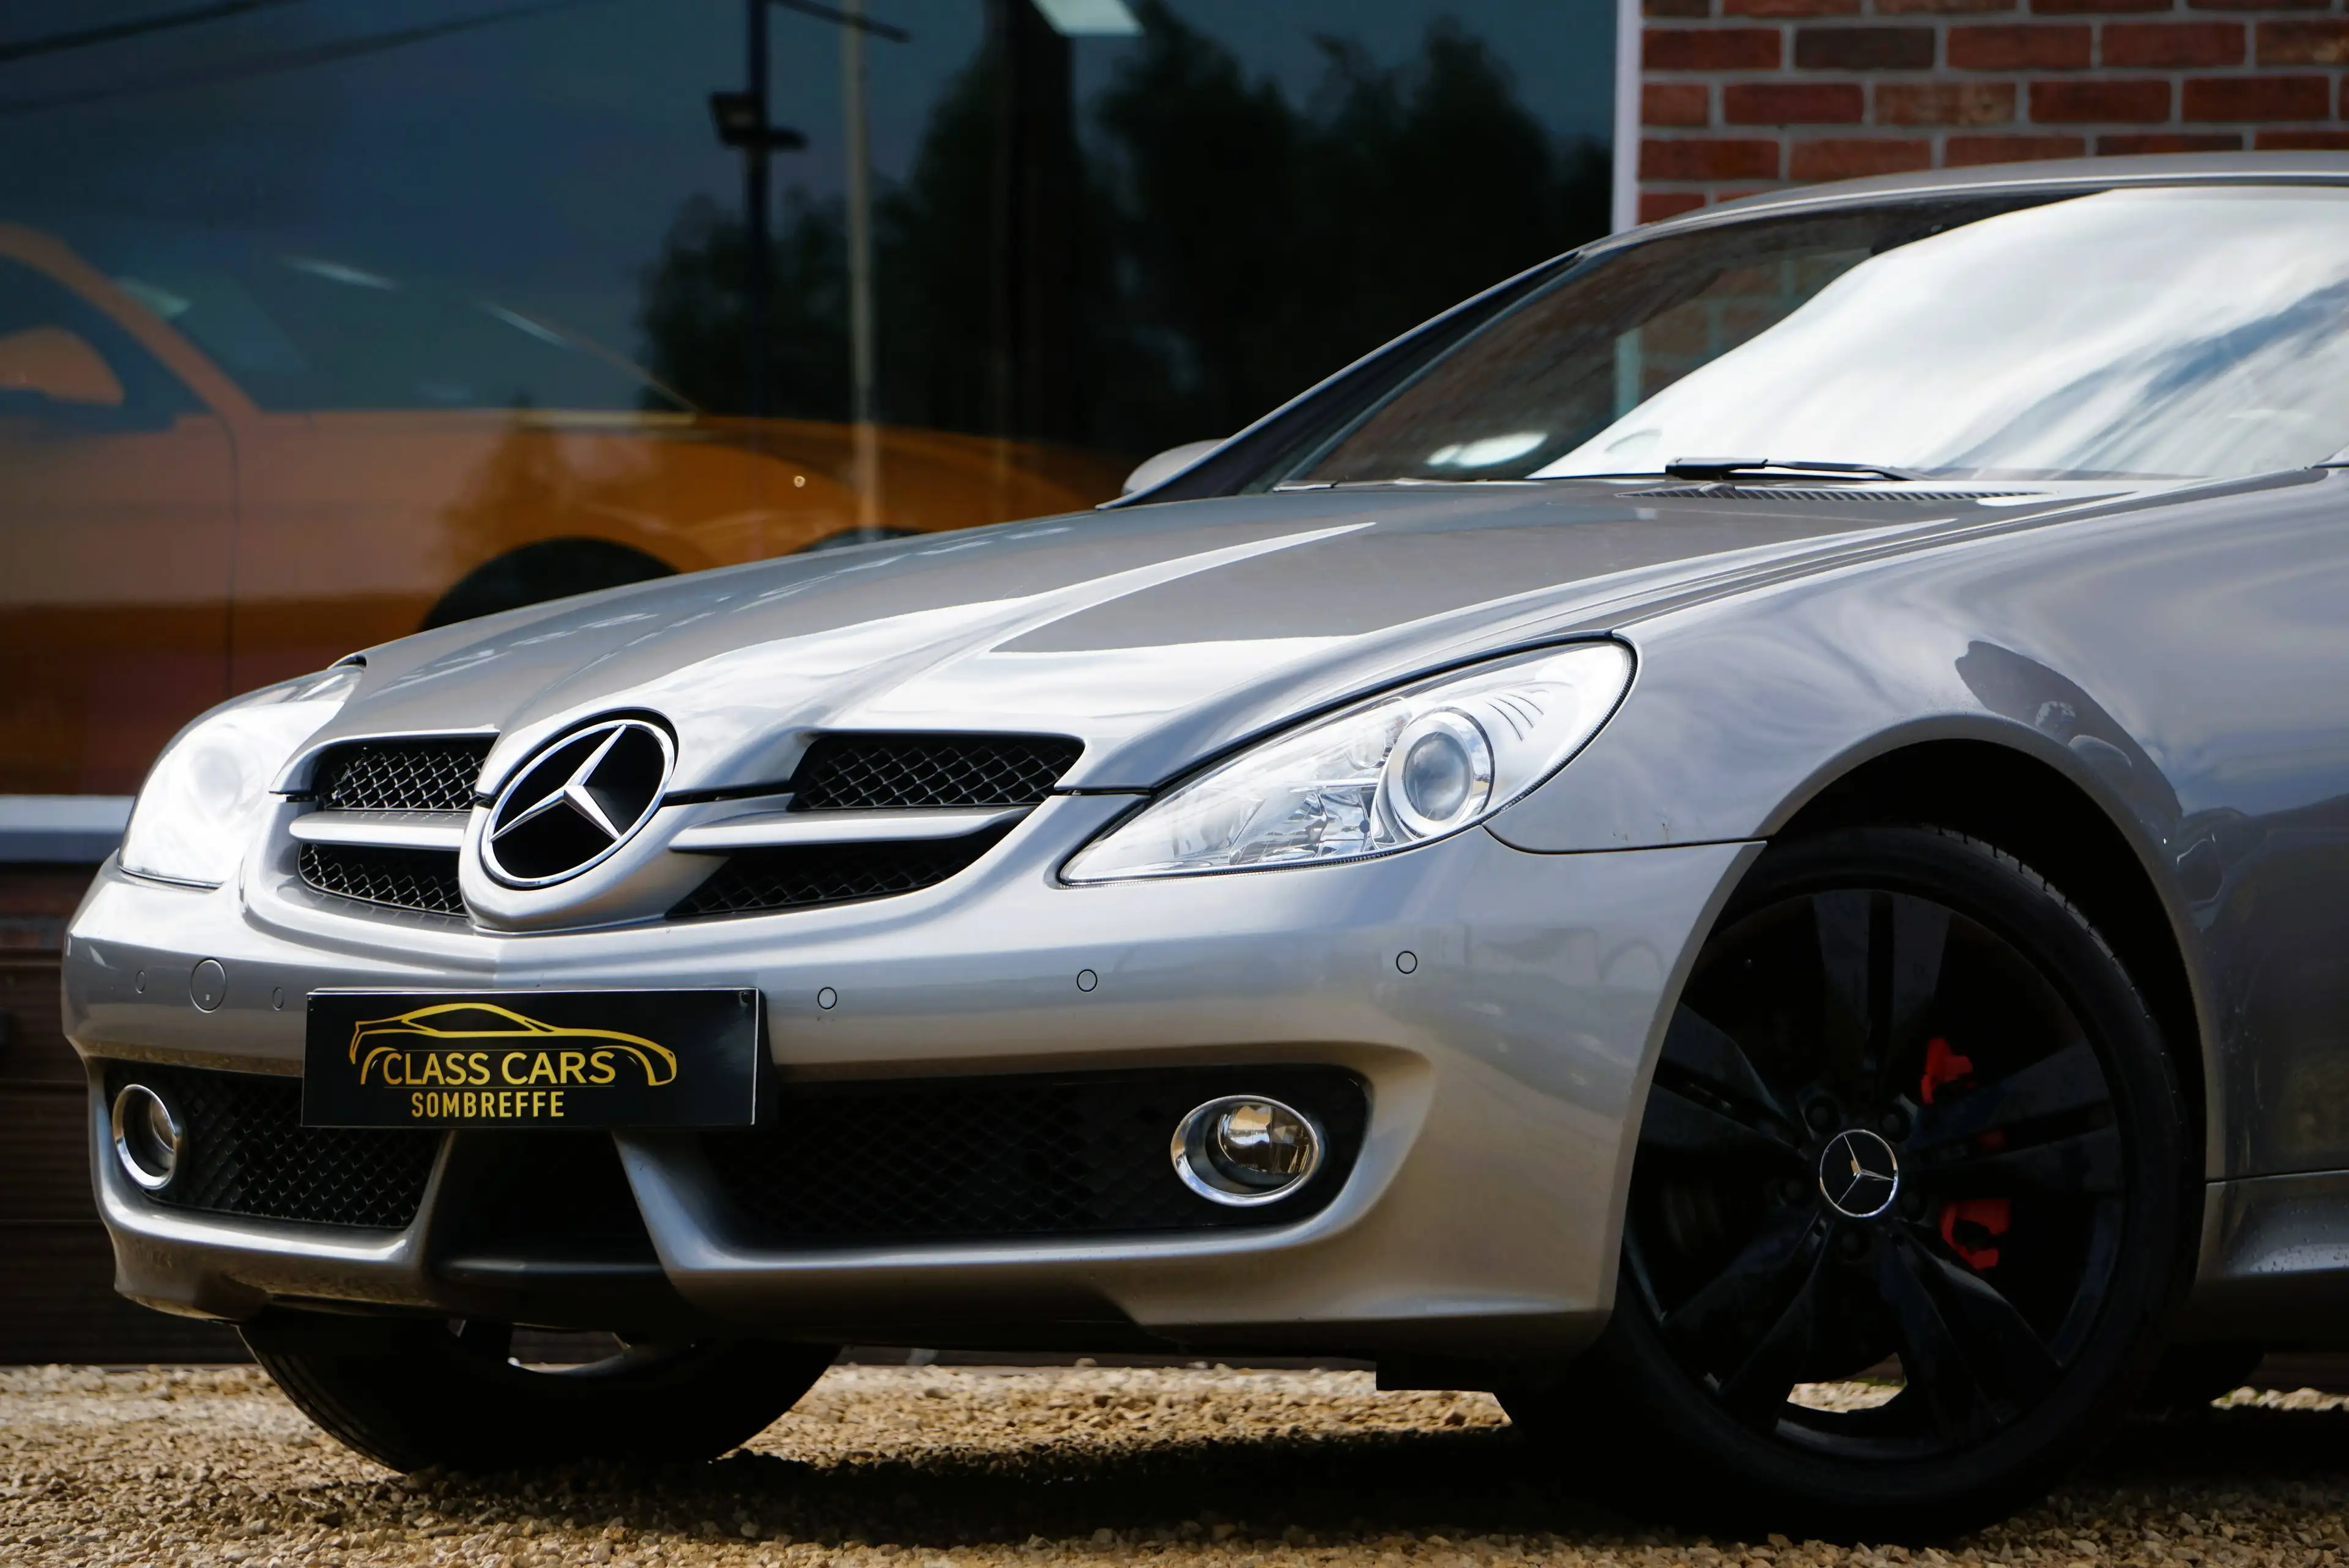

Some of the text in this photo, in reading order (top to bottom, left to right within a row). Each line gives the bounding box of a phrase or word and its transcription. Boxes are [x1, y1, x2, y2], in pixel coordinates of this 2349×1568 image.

[383, 1051, 615, 1085] CLASS CARS
[412, 1092, 564, 1117] SOMBREFFE
